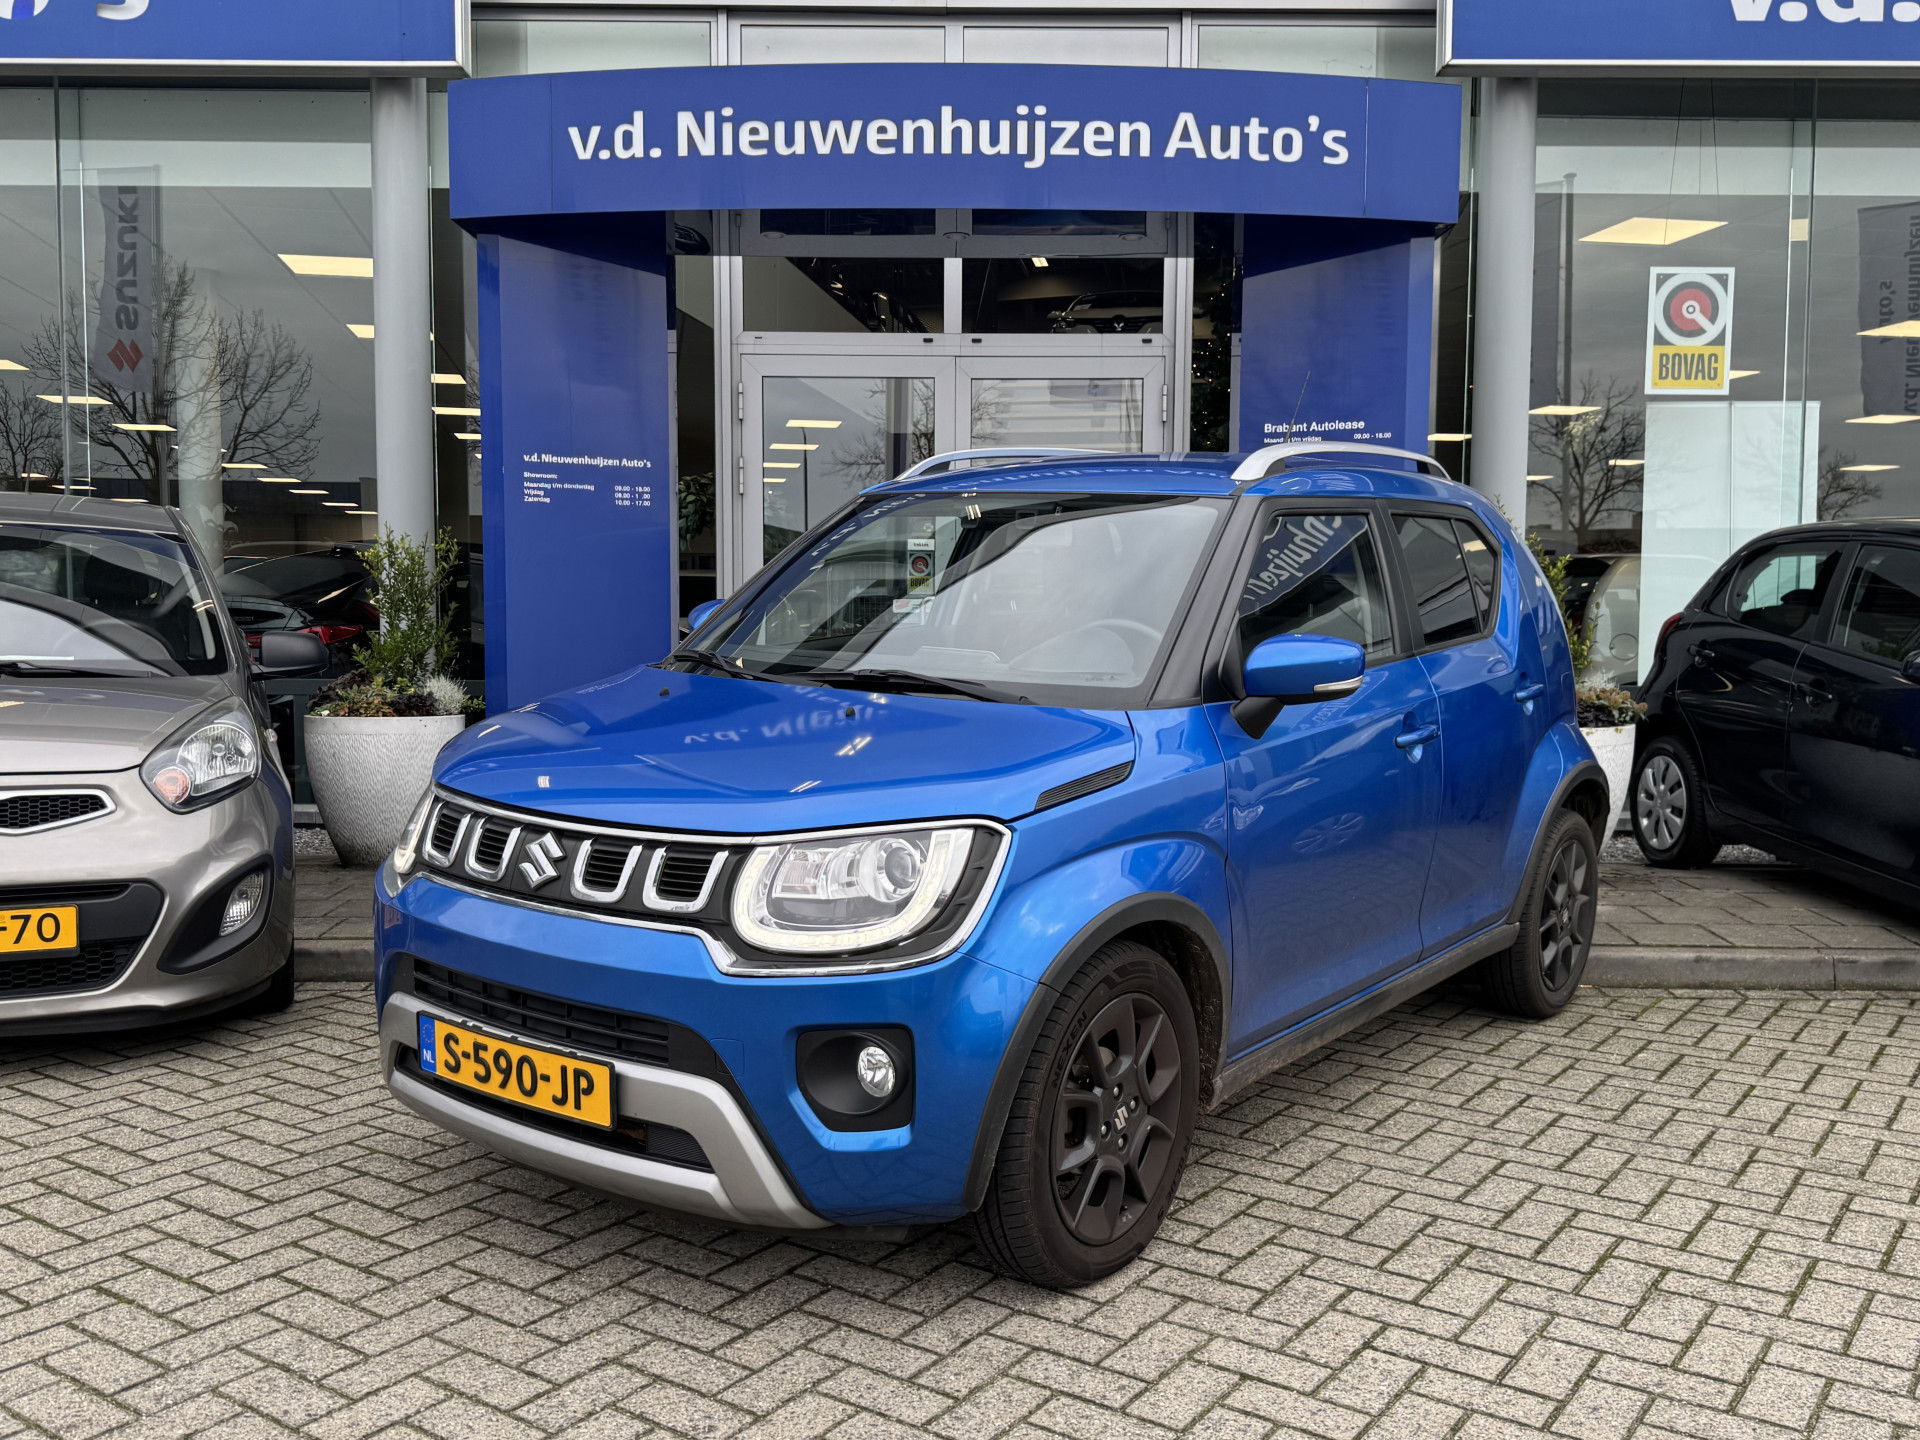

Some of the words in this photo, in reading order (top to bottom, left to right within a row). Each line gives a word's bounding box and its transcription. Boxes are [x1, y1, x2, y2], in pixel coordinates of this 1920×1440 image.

[568, 110, 662, 160] v.d.
[677, 105, 1151, 168] Nieuwenhuijzen
[1164, 111, 1349, 164] Auto's
[1658, 353, 1719, 381] BOVAG
[1264, 422, 1307, 433] Brabant
[1310, 419, 1365, 432] Autolease
[524, 452, 540, 462] v.d.
[542, 454, 619, 468] Nieuwenhuijzen
[621, 458, 652, 468] Auto's
[563, 483, 595, 491] donderdag
[423, 1048, 435, 1064] NL
[1051, 1010, 1088, 1089] NEXEN
[443, 1032, 595, 1111] S-590-JP
